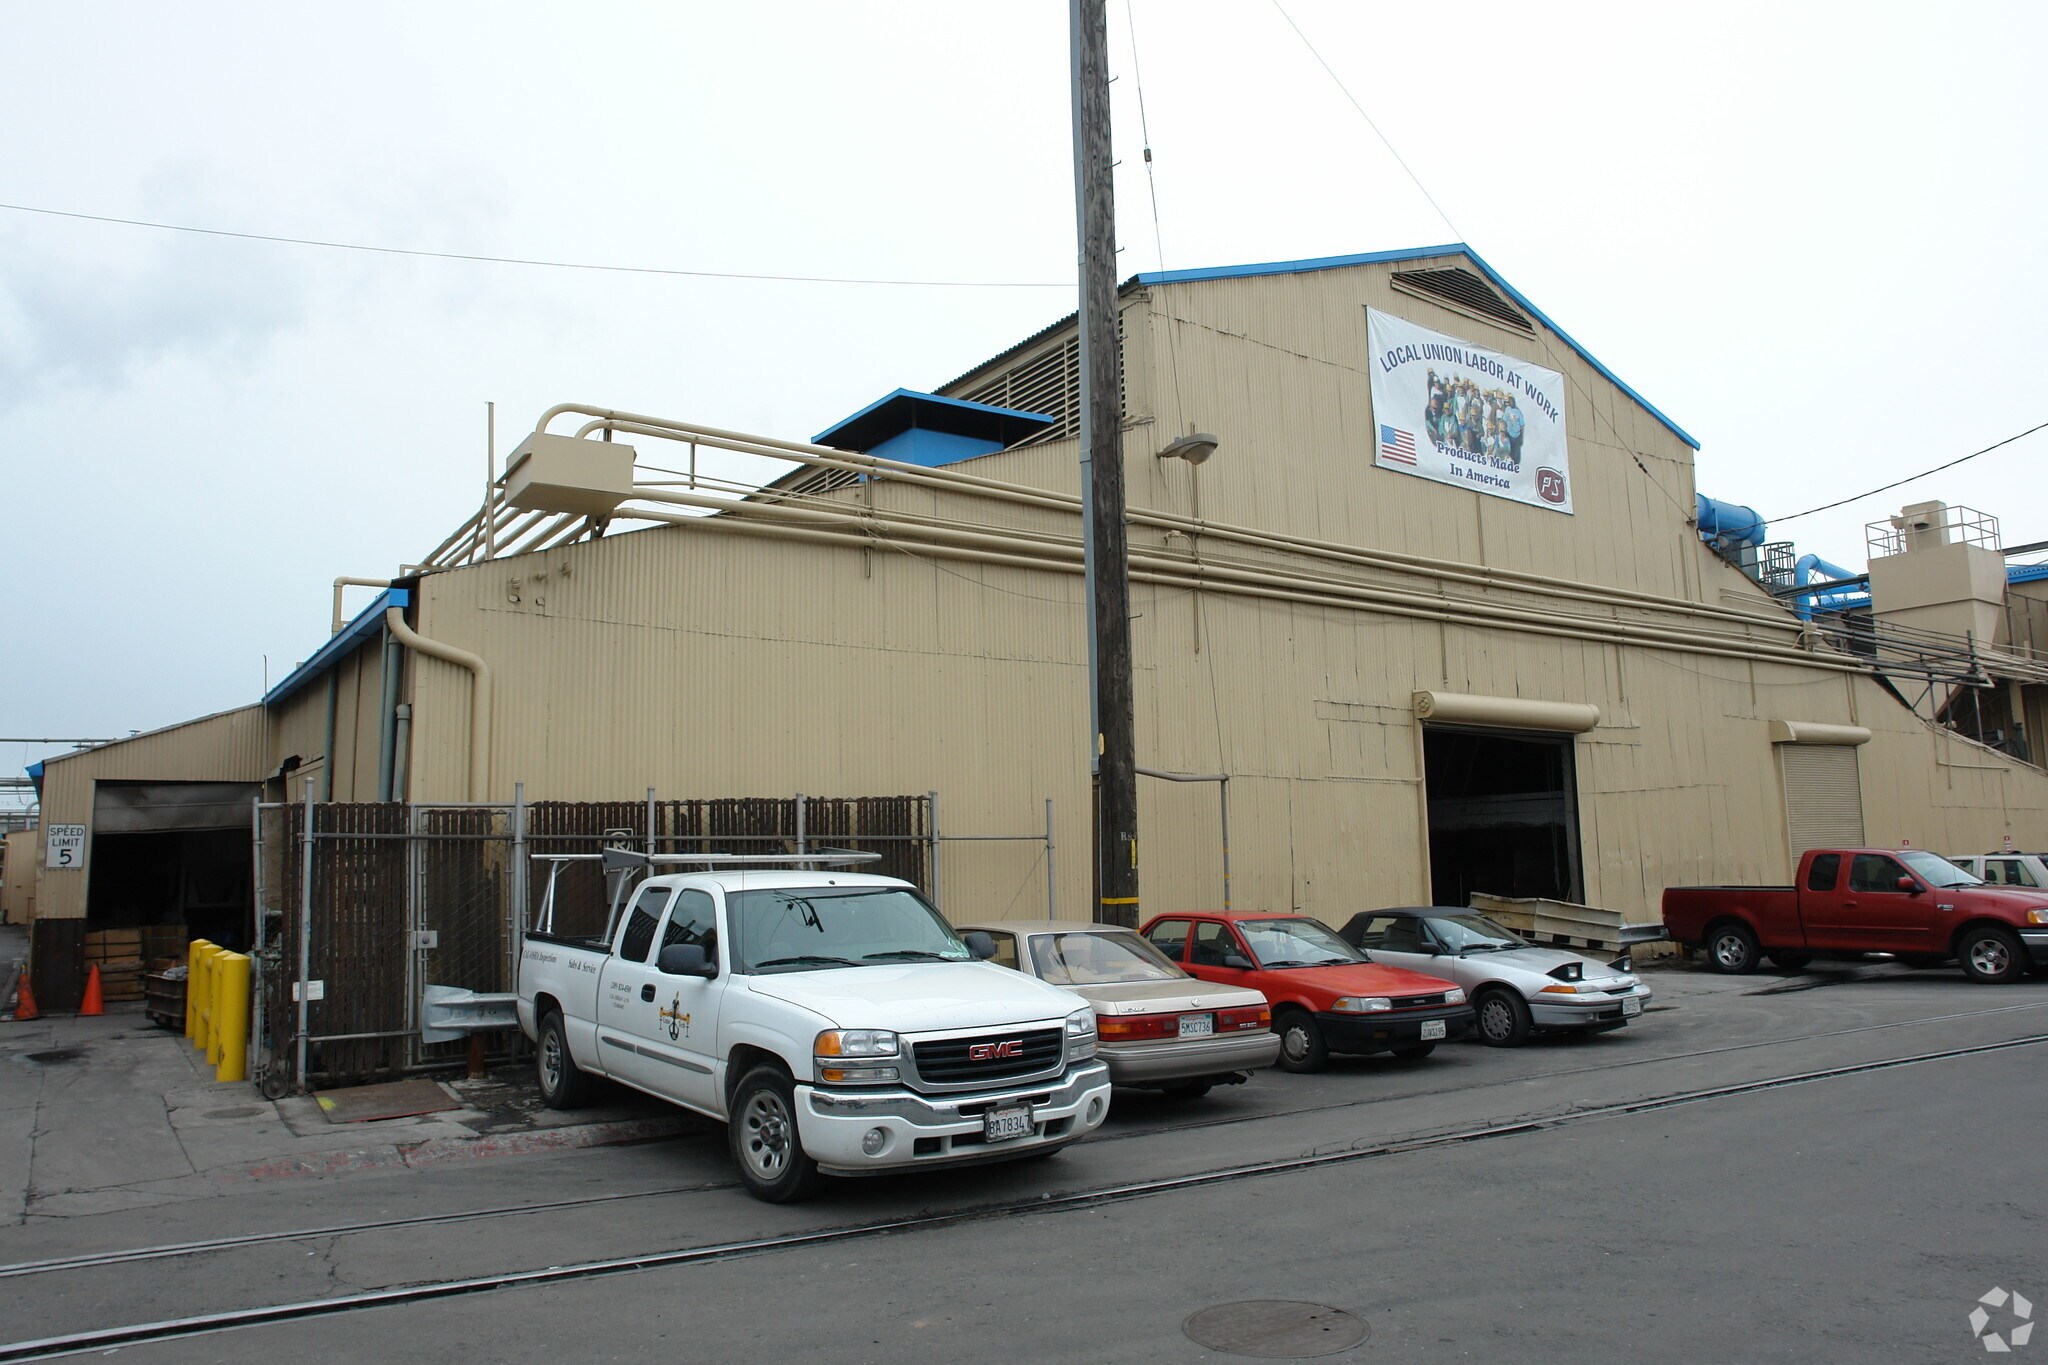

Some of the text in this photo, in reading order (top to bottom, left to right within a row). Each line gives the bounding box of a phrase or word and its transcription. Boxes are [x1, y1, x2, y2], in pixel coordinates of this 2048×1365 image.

[1380, 343, 1559, 423] LOCAL UNION LABOR AT WORK
[1436, 441, 1520, 473] Products Made
[1450, 463, 1510, 489] In America
[50, 827, 84, 836] SPEED
[52, 838, 80, 846] LIMIT
[59, 849, 72, 865] 5
[582, 962, 596, 974] Service
[1181, 1021, 1210, 1034] 5MSC736
[970, 1040, 1023, 1060] GMC
